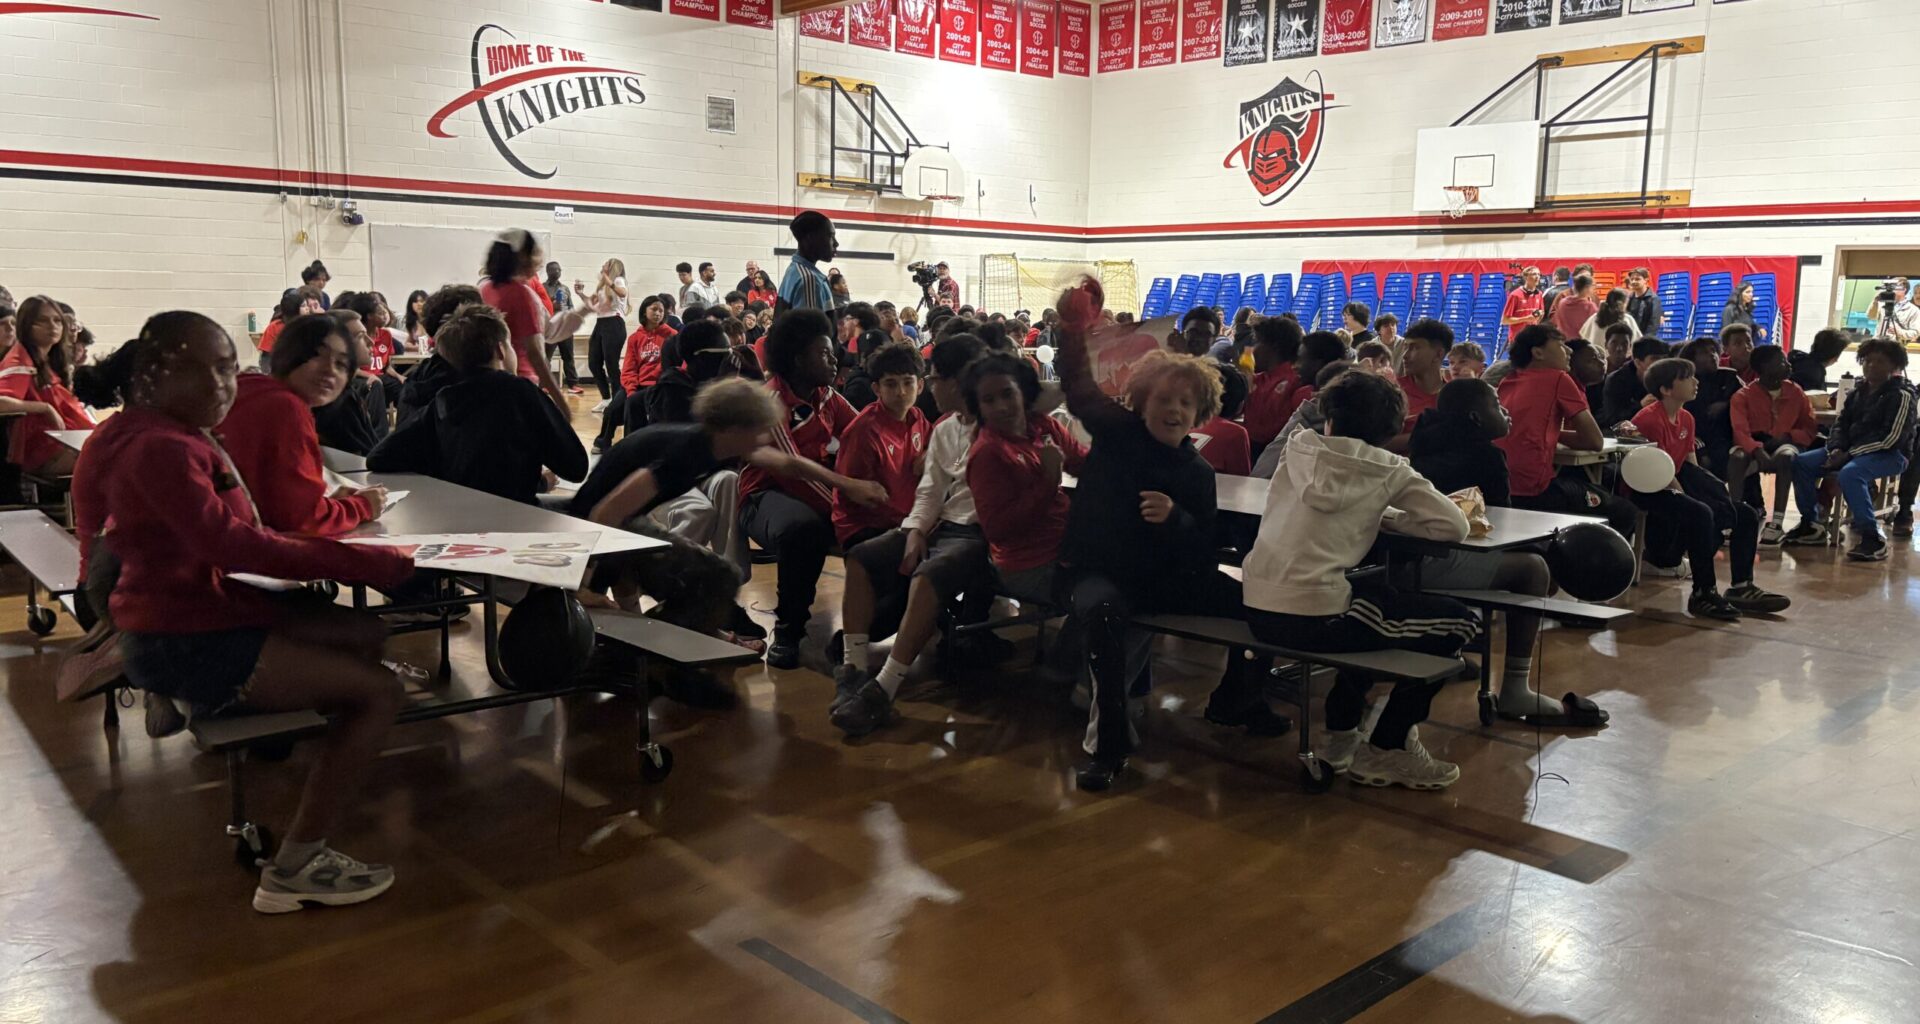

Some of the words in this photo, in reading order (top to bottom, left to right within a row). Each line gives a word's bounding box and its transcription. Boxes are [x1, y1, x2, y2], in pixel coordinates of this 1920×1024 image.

[674, 0, 715, 12] CHAMPIONS
[741, 5, 759, 13] ZONE
[1502, 0, 1547, 12] 2010-2011
[731, 9, 769, 22] CHAMPIONS
[1440, 8, 1483, 21] 2009-2010
[1453, 18, 1485, 28] CHAMPIONS
[903, 23, 930, 36] 2000-01
[946, 32, 971, 43] 2001-02
[1184, 35, 1219, 46] 2007-2008
[1330, 30, 1366, 41] 2008-2009
[986, 40, 1011, 50] 2003-04
[1140, 42, 1174, 53] 2007-2008
[1026, 46, 1048, 57] 2004-05
[1184, 51, 1216, 60] CHAMPIONS
[486, 44, 534, 76] HOME
[536, 44, 554, 63] OF
[558, 48, 588, 62] THE
[1142, 56, 1172, 66] CHAMPIONS
[494, 76, 646, 142] KNIGHTS
[1240, 90, 1315, 138] KNIGHTS
[370, 356, 383, 370] 20
